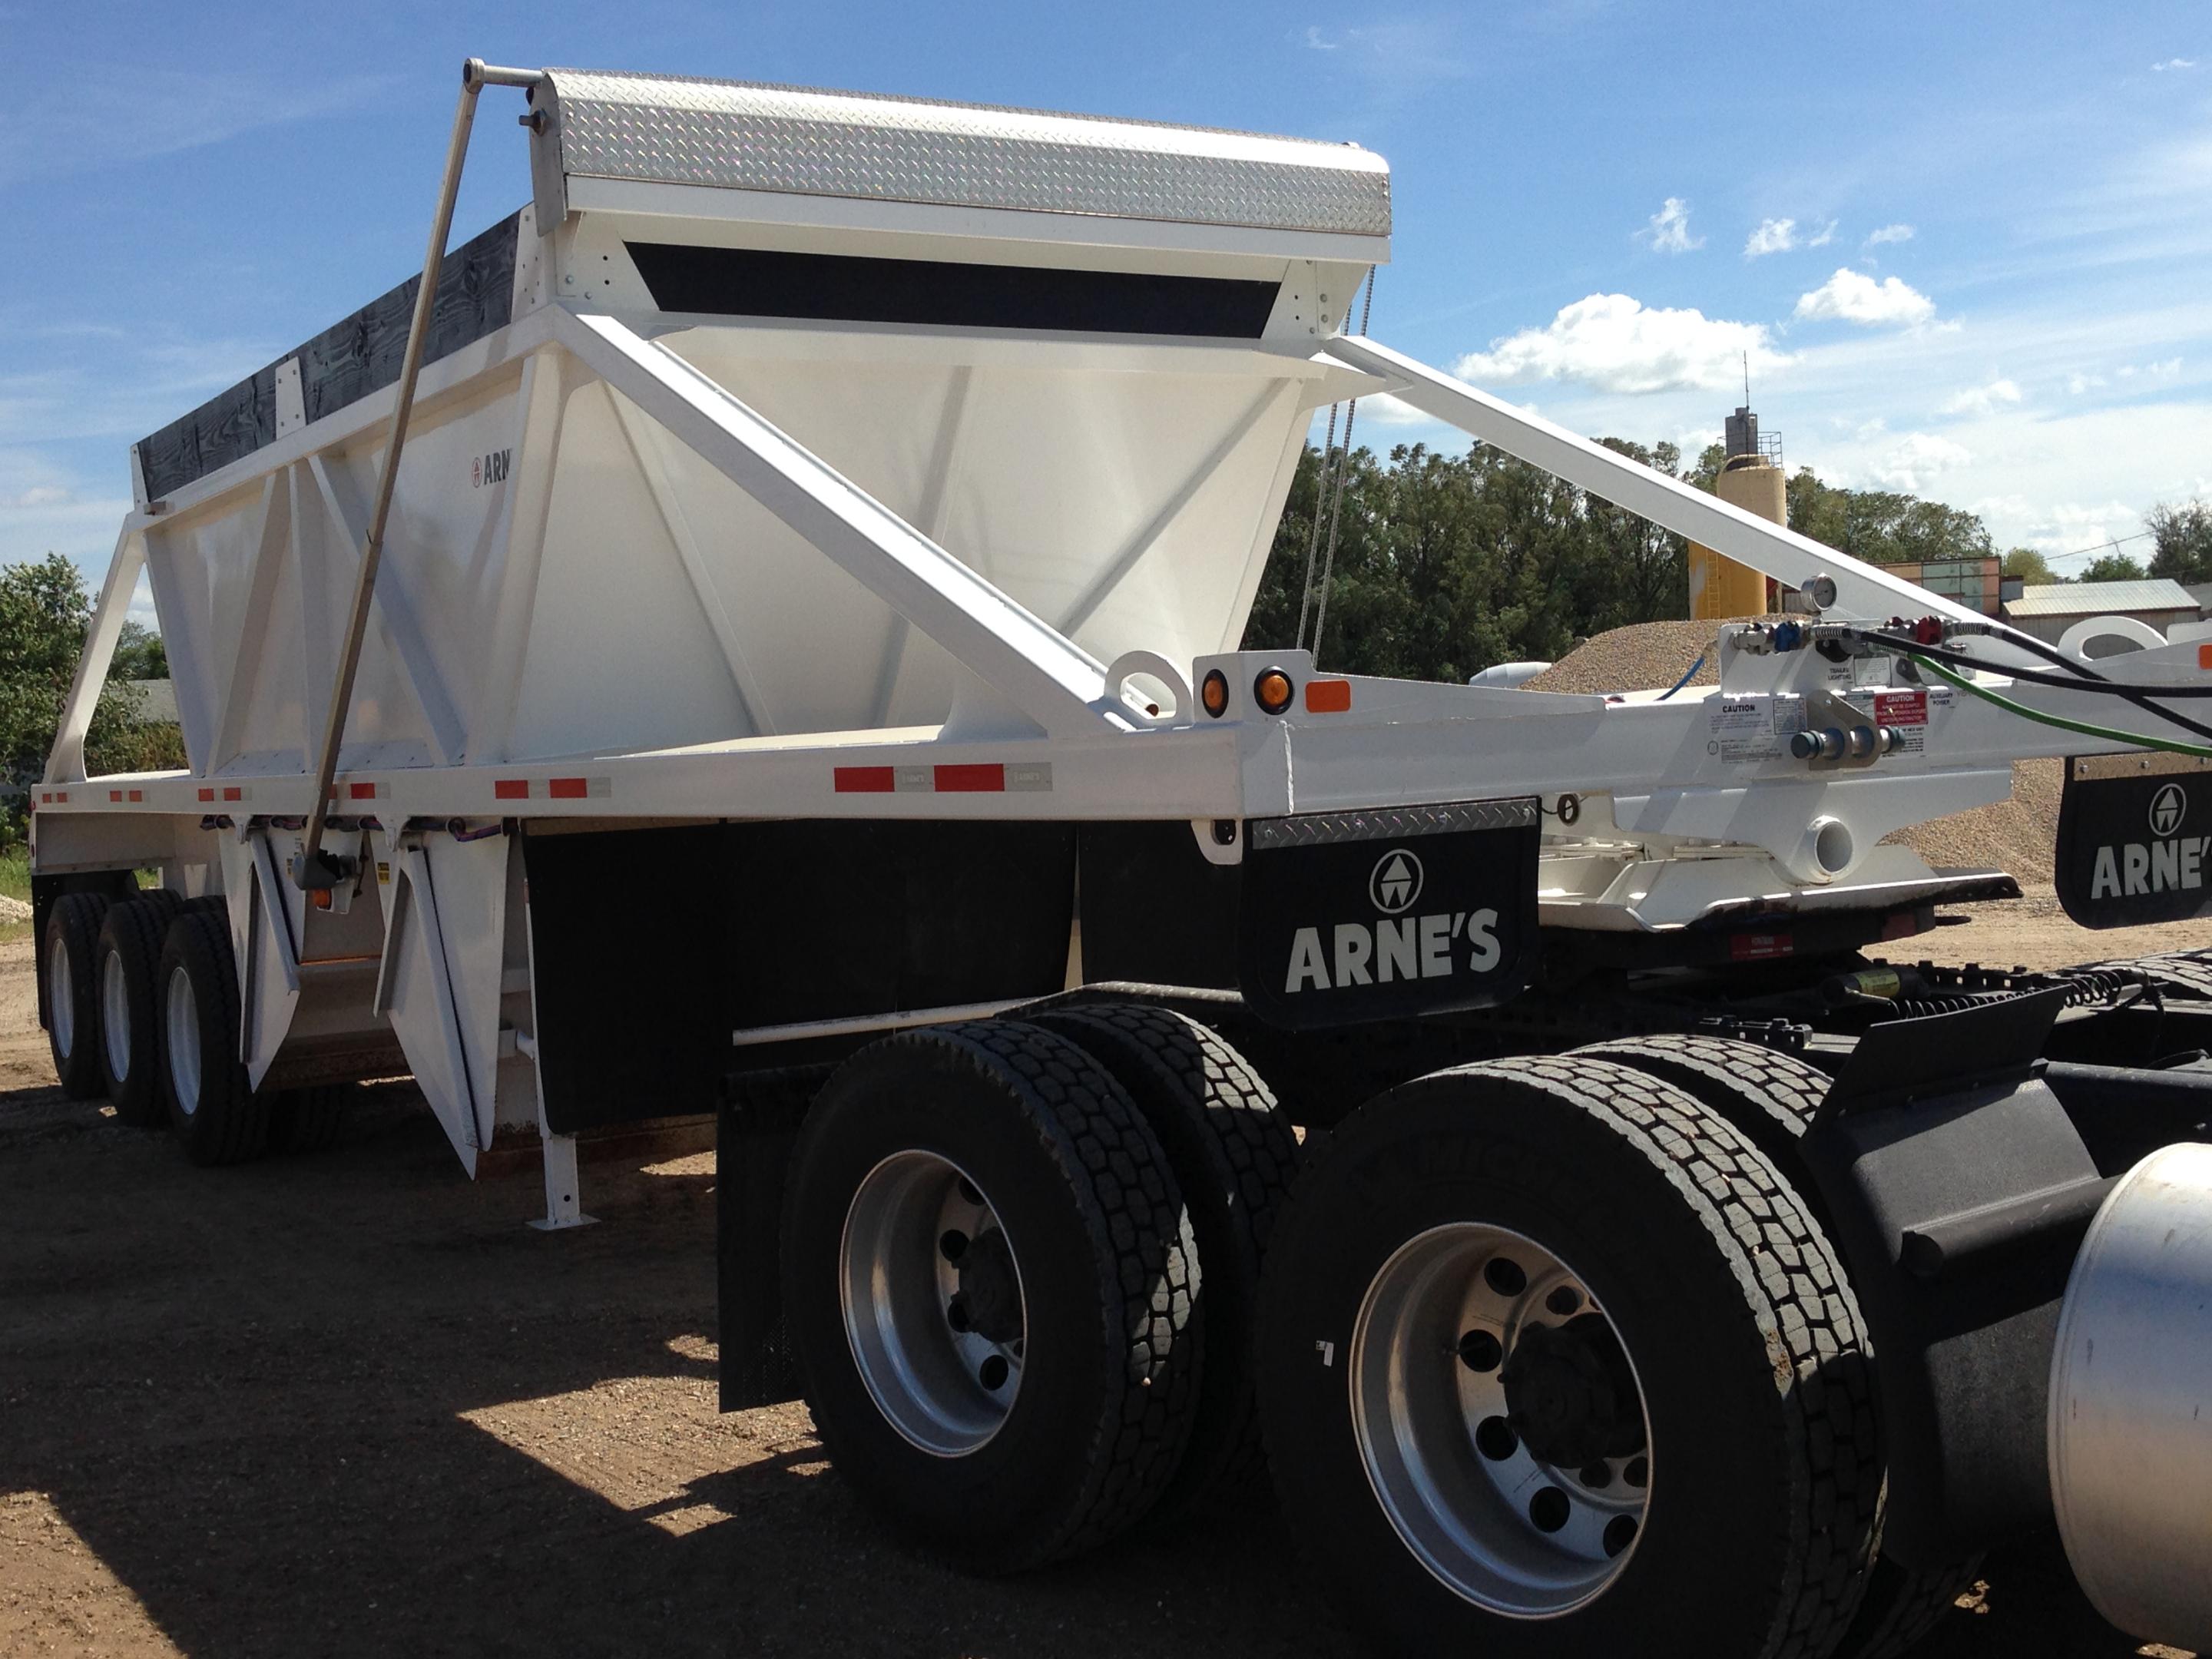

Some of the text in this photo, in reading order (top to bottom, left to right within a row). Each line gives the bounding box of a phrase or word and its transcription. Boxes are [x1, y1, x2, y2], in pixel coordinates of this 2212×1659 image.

[484, 448, 511, 485] ARN
[1722, 704, 1756, 713] CAUTION
[1886, 694, 1915, 703] CAUTION
[2091, 836, 2212, 899] ARNE'
[1285, 908, 1502, 993] ARNE'S
